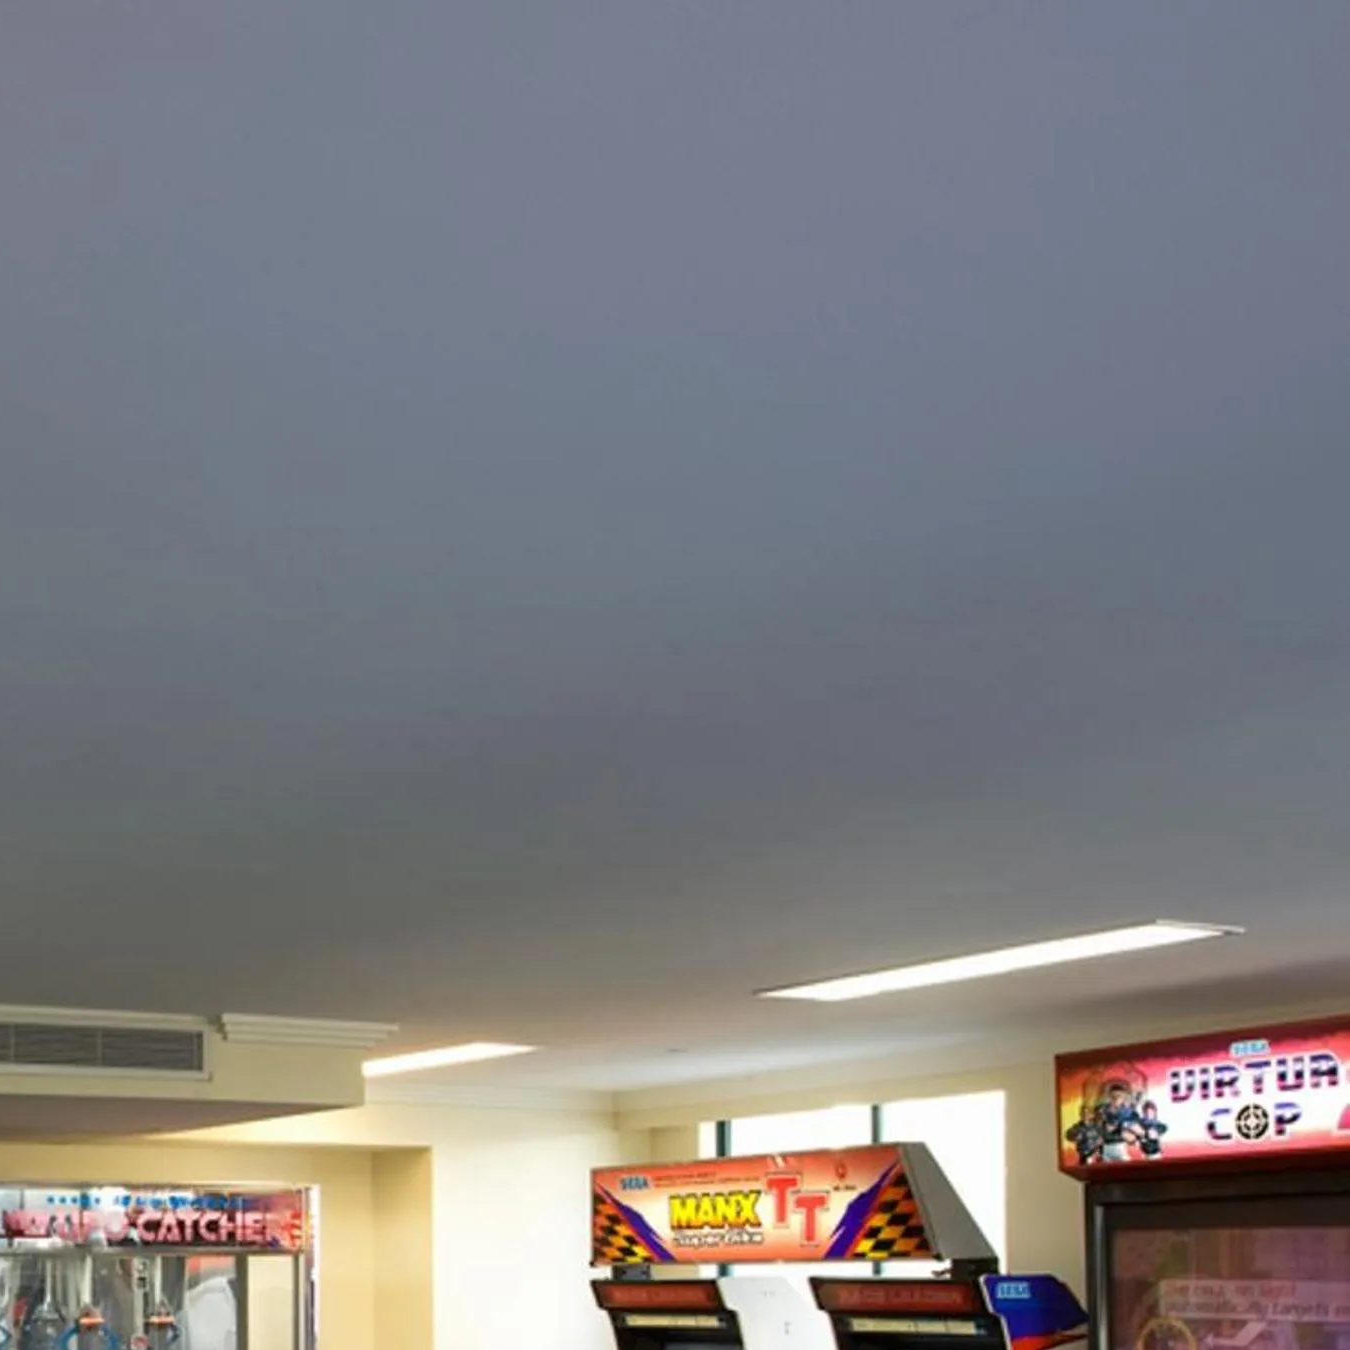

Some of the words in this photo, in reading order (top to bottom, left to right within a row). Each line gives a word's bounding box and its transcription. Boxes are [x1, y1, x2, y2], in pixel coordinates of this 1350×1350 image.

[1169, 1053, 1340, 1103] VIRTUA
[1206, 1102, 1302, 1141] COP
[620, 1176, 648, 1191] SEGA
[136, 1210, 288, 1242] CATCHER
[669, 1190, 763, 1230] MANX
